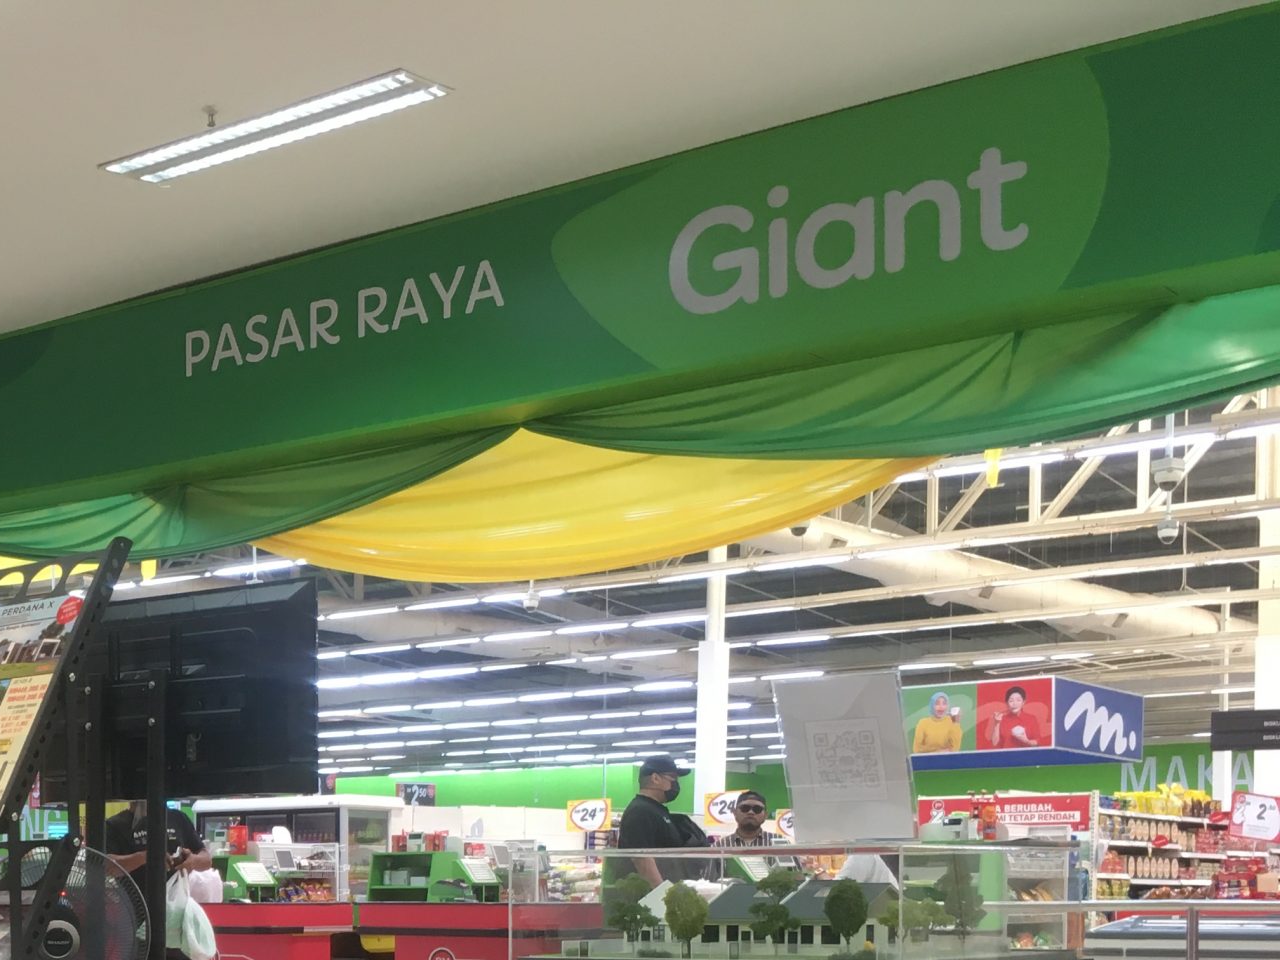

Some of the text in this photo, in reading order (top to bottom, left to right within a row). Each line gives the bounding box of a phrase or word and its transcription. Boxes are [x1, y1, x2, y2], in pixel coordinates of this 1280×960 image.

[669, 147, 1029, 315] Giant
[185, 259, 505, 378] PASAR RAYA
[2, 602, 45, 617] PERDANA
[580, 807, 597, 822] 24
[1008, 813, 1036, 822] TETAP
[1256, 803, 1266, 820] 2
